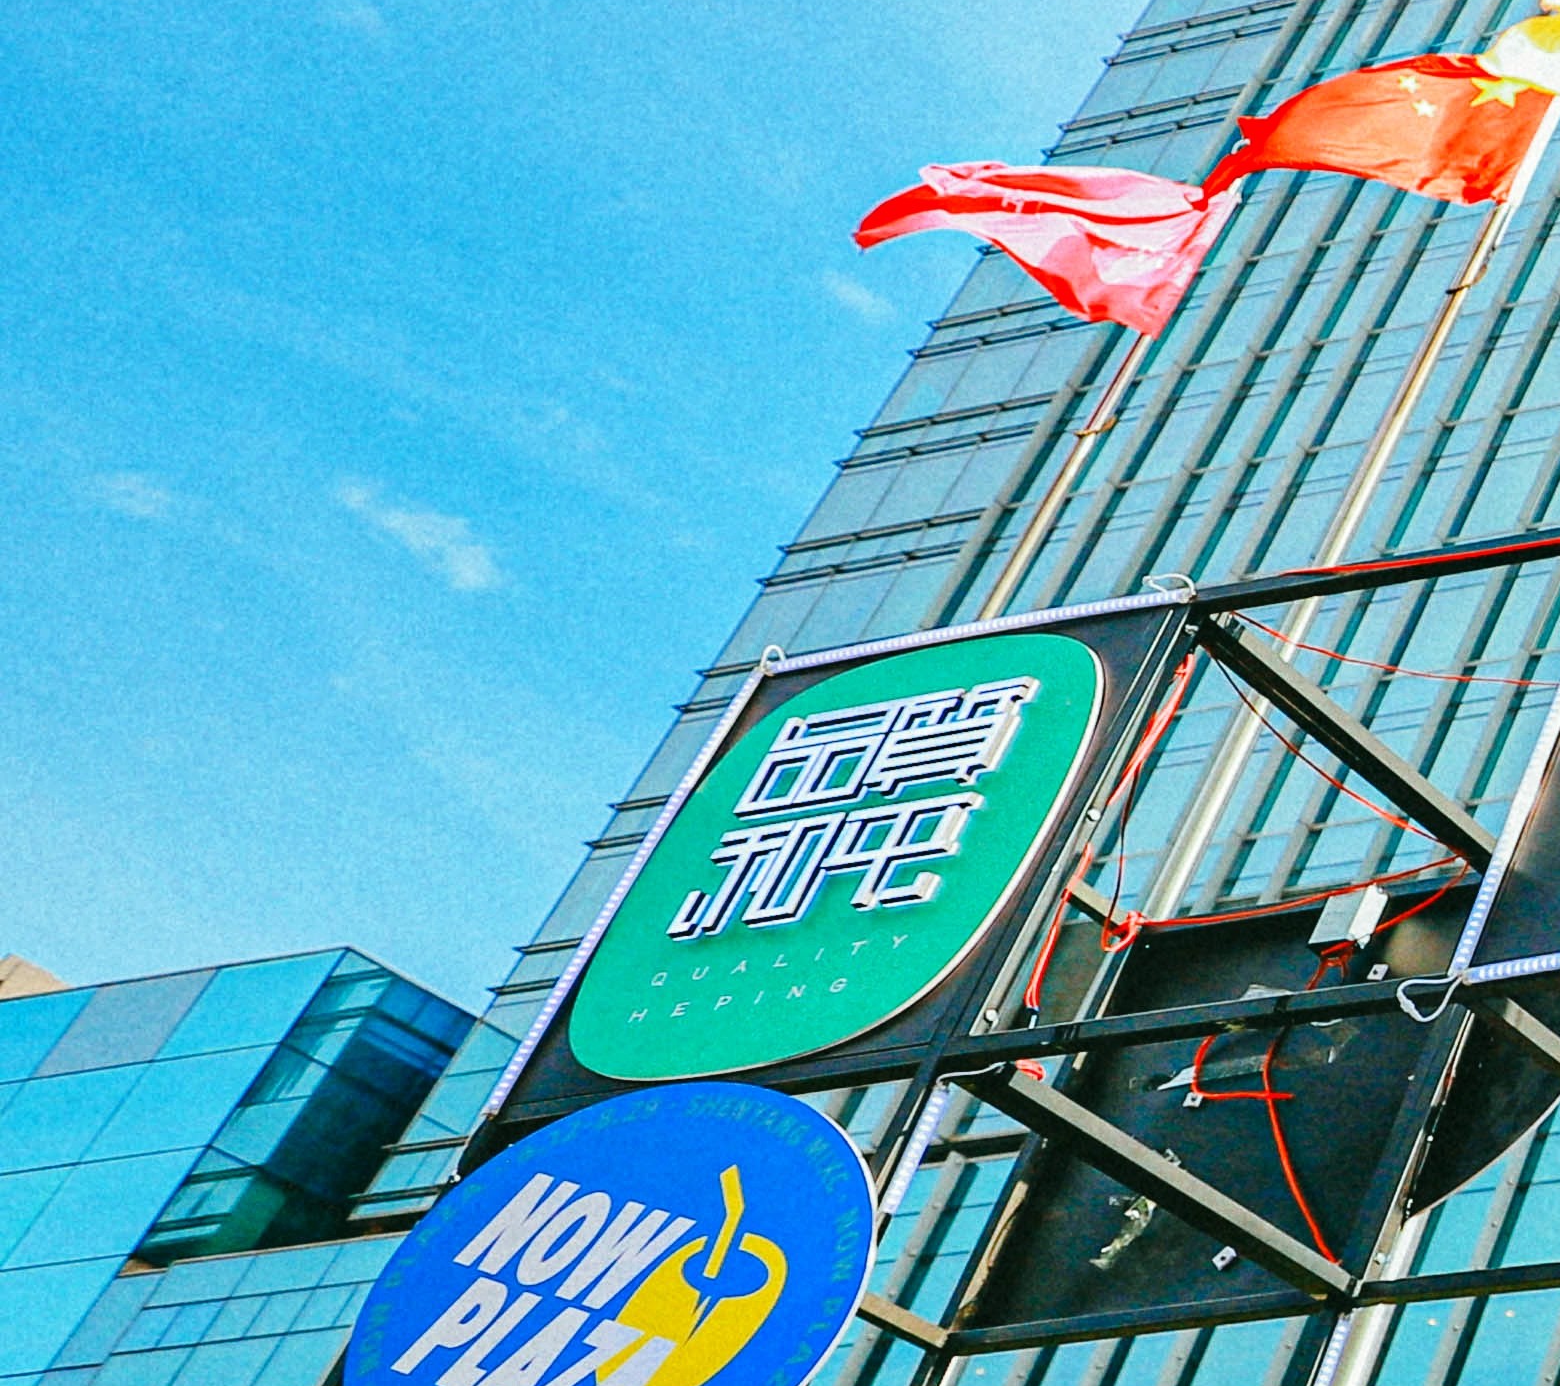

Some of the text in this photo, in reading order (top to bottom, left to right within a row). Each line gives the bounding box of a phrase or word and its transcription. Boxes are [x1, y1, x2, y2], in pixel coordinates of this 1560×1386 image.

[650, 935, 910, 987] QUALITY
[627, 977, 849, 1024] HEPING
[453, 1173, 696, 1309] NOW
